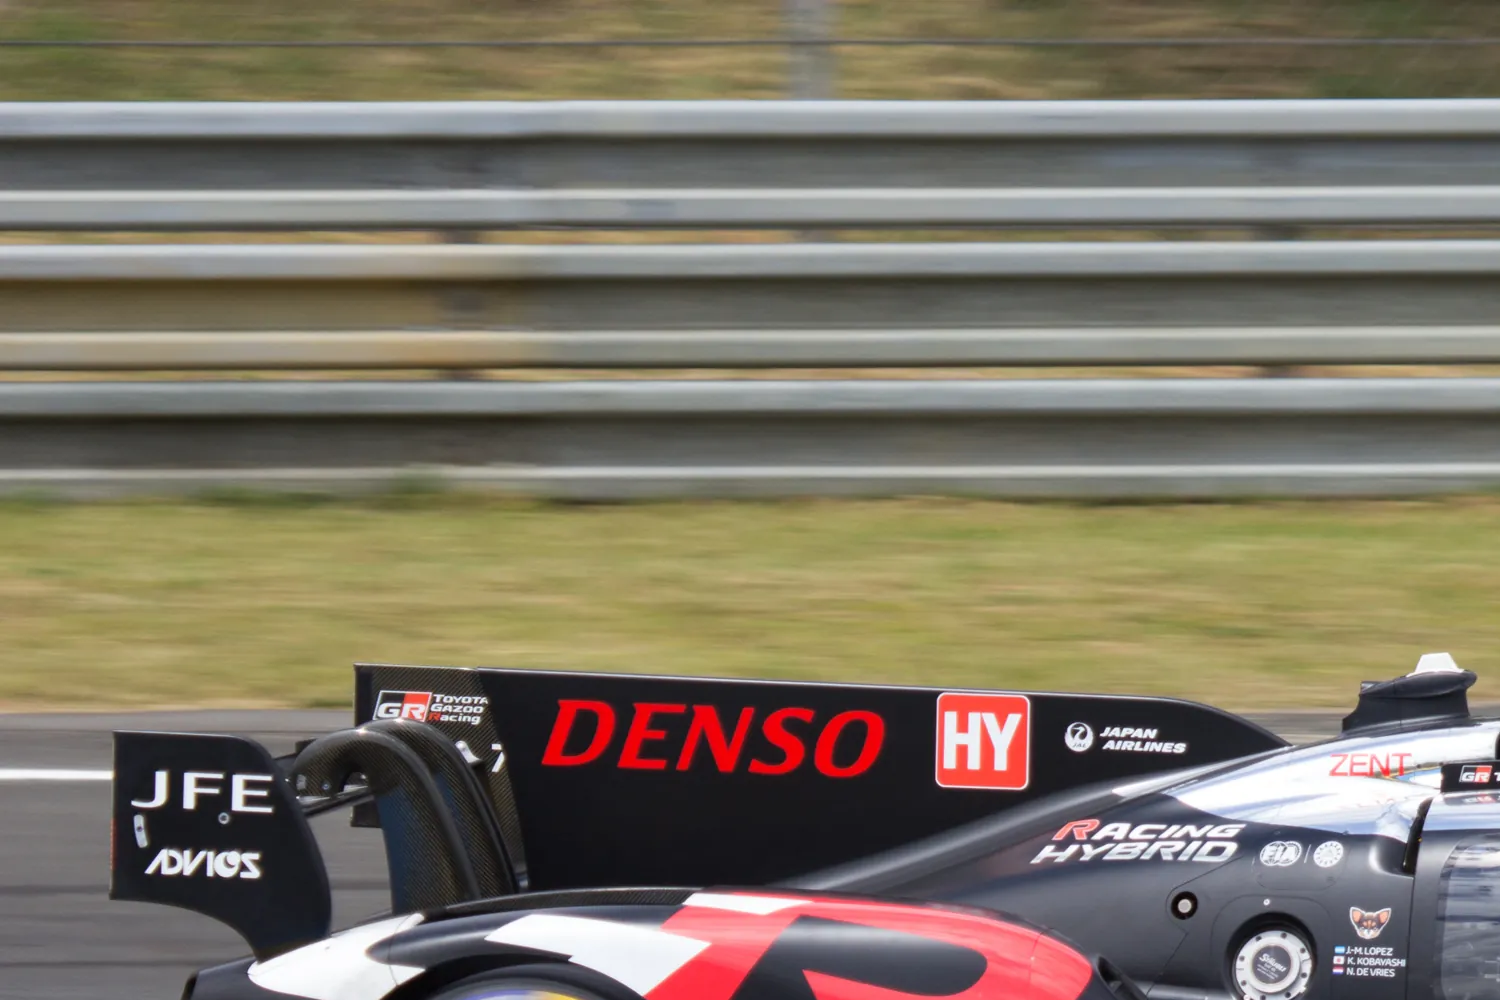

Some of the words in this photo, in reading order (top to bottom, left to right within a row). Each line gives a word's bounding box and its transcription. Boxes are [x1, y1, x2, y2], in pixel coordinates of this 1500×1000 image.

[433, 694, 488, 704] TOYOTA
[377, 702, 427, 719] GR
[431, 703, 484, 713] GAZOO
[429, 712, 481, 725] Racing
[541, 699, 886, 779] DENSO
[1100, 727, 1158, 739] JAPAN
[942, 711, 1022, 771] HY
[1103, 740, 1187, 754] AIRLINES
[491, 743, 505, 773] 7
[1329, 753, 1412, 777] ZENT
[1461, 772, 1490, 782] GR
[131, 771, 273, 813] JFE
[1052, 819, 1247, 841] RACING
[1030, 840, 1238, 865] HYBRID
[1364, 947, 1393, 956] LOPEZ
[1347, 957, 1356, 965] K.
[1356, 957, 1406, 967] KOBAYASHI
[1346, 968, 1356, 976] N.
[1357, 968, 1369, 976] DE
[1369, 968, 1396, 977] VRIES
